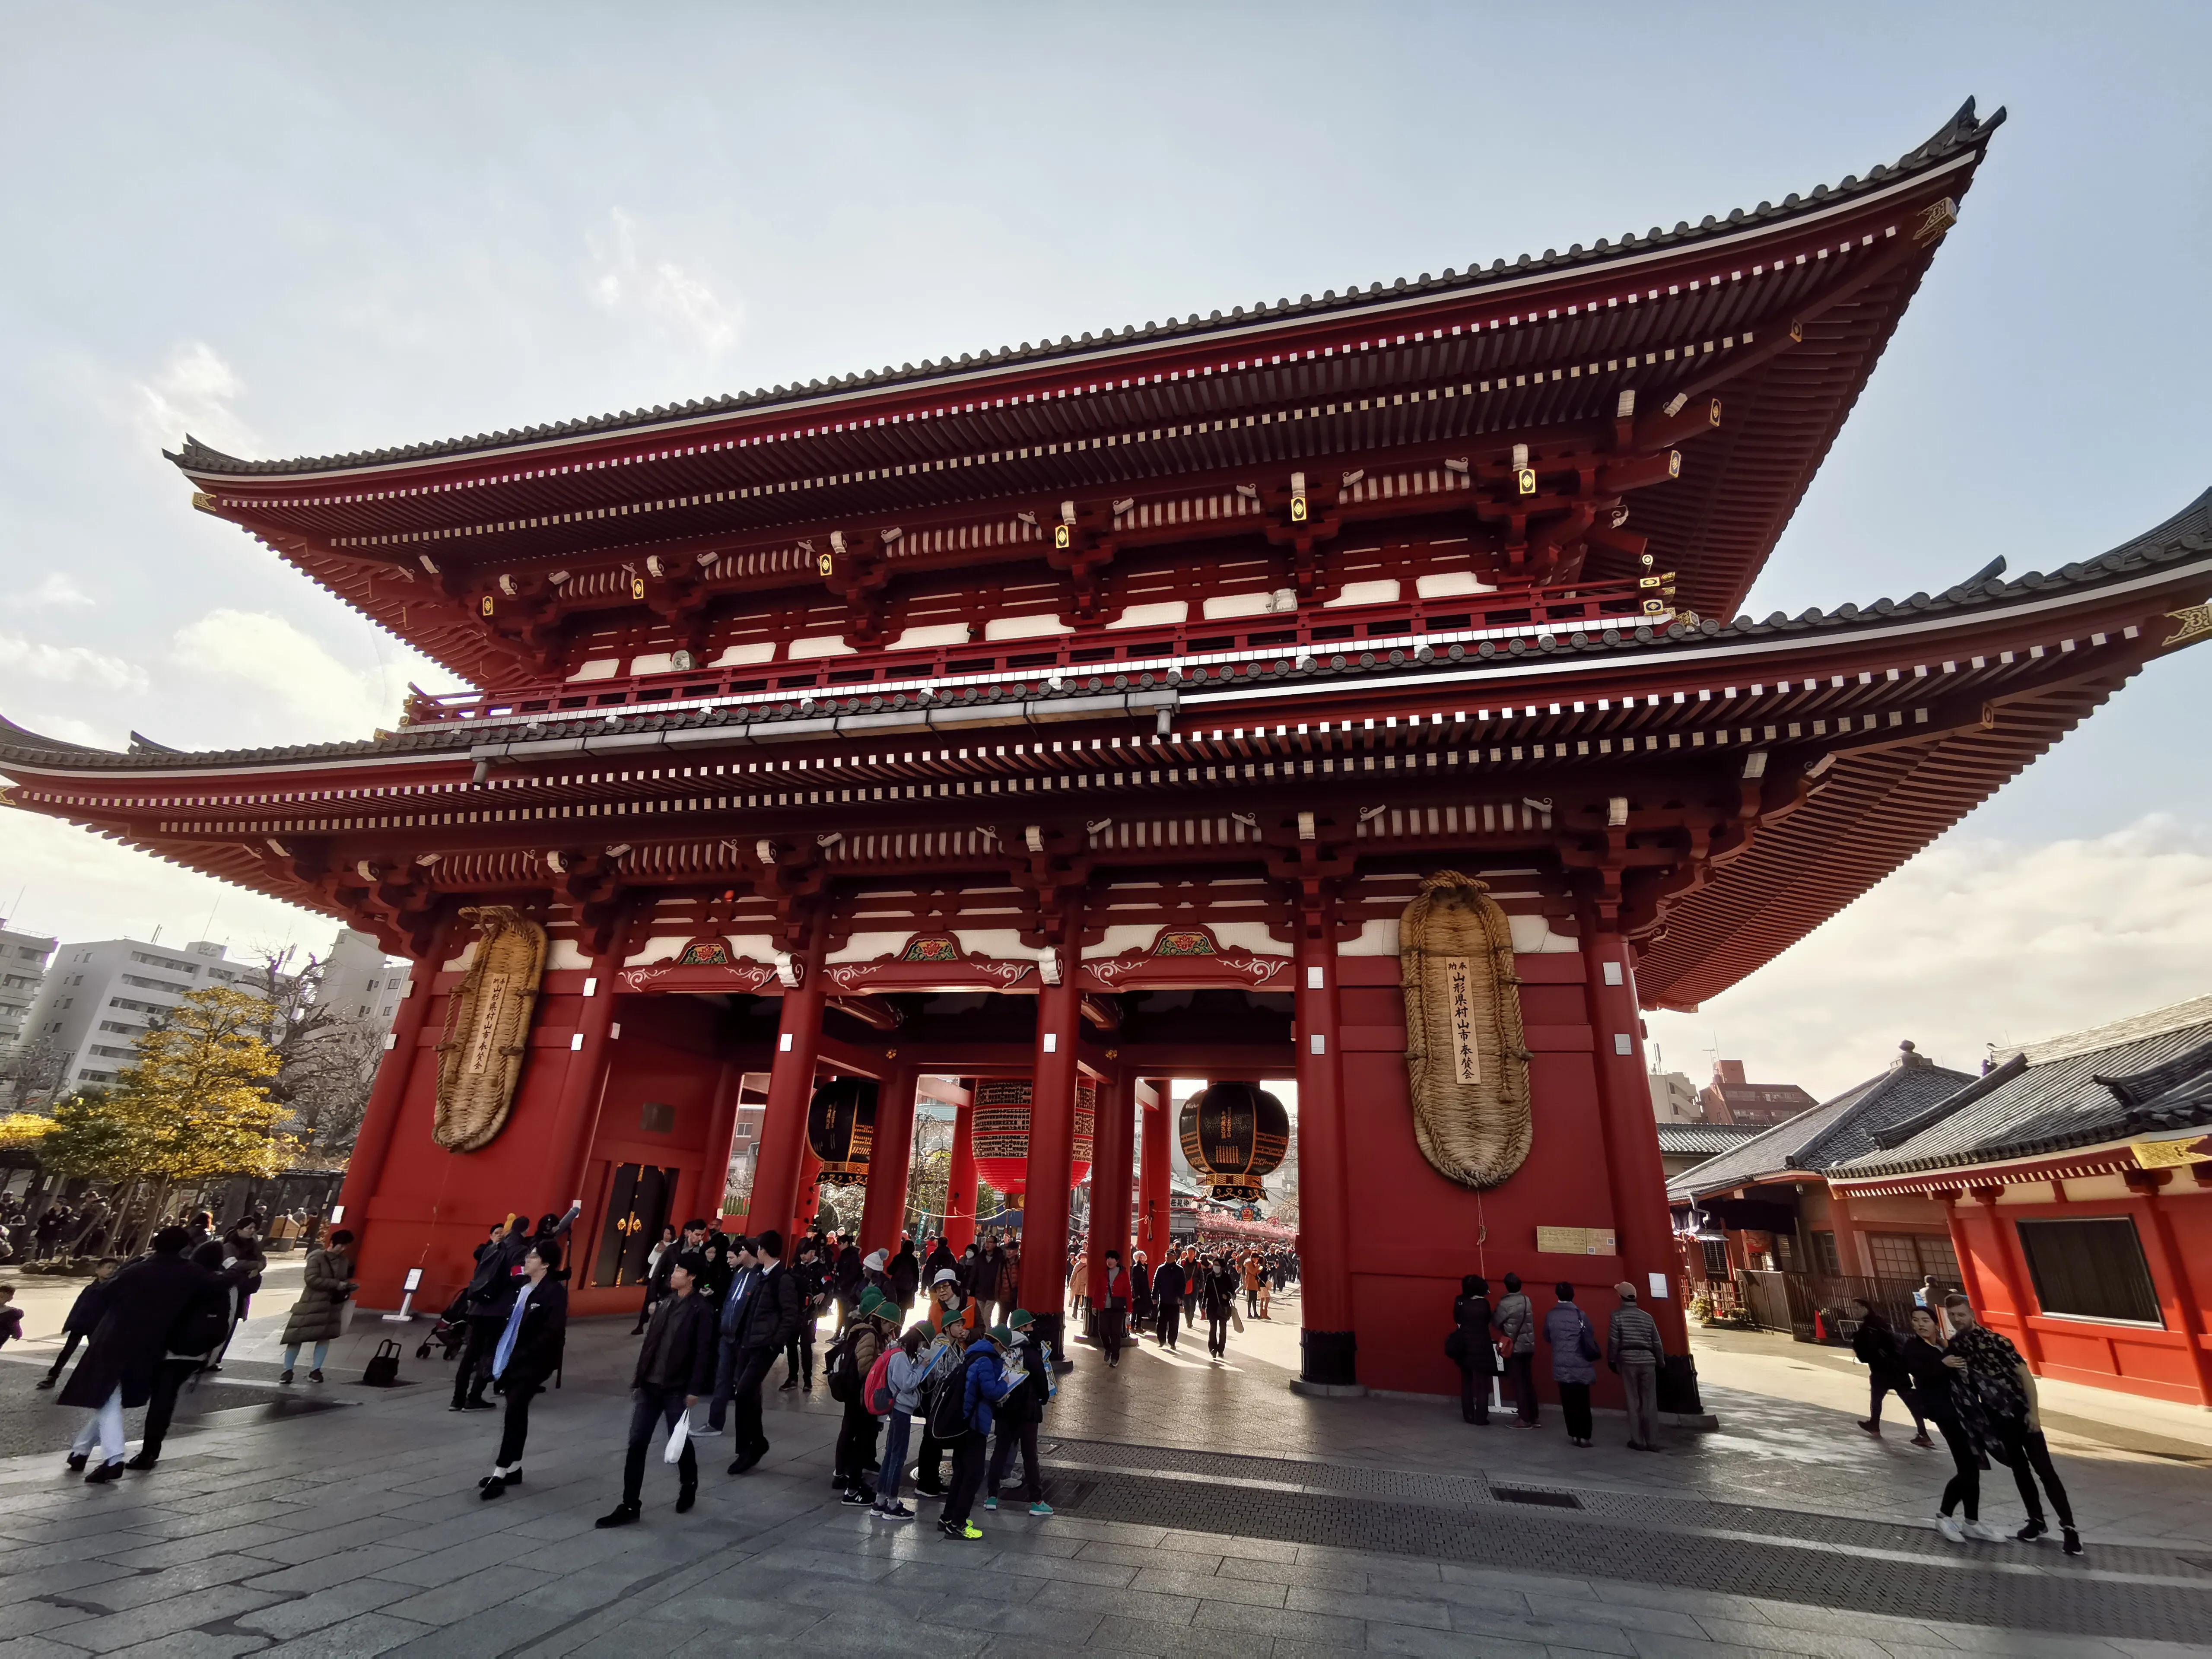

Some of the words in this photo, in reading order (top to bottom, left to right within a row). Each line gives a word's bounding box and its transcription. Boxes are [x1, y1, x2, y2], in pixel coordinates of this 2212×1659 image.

[1452, 972, 1475, 1079] 山形県村山市奉賛会
